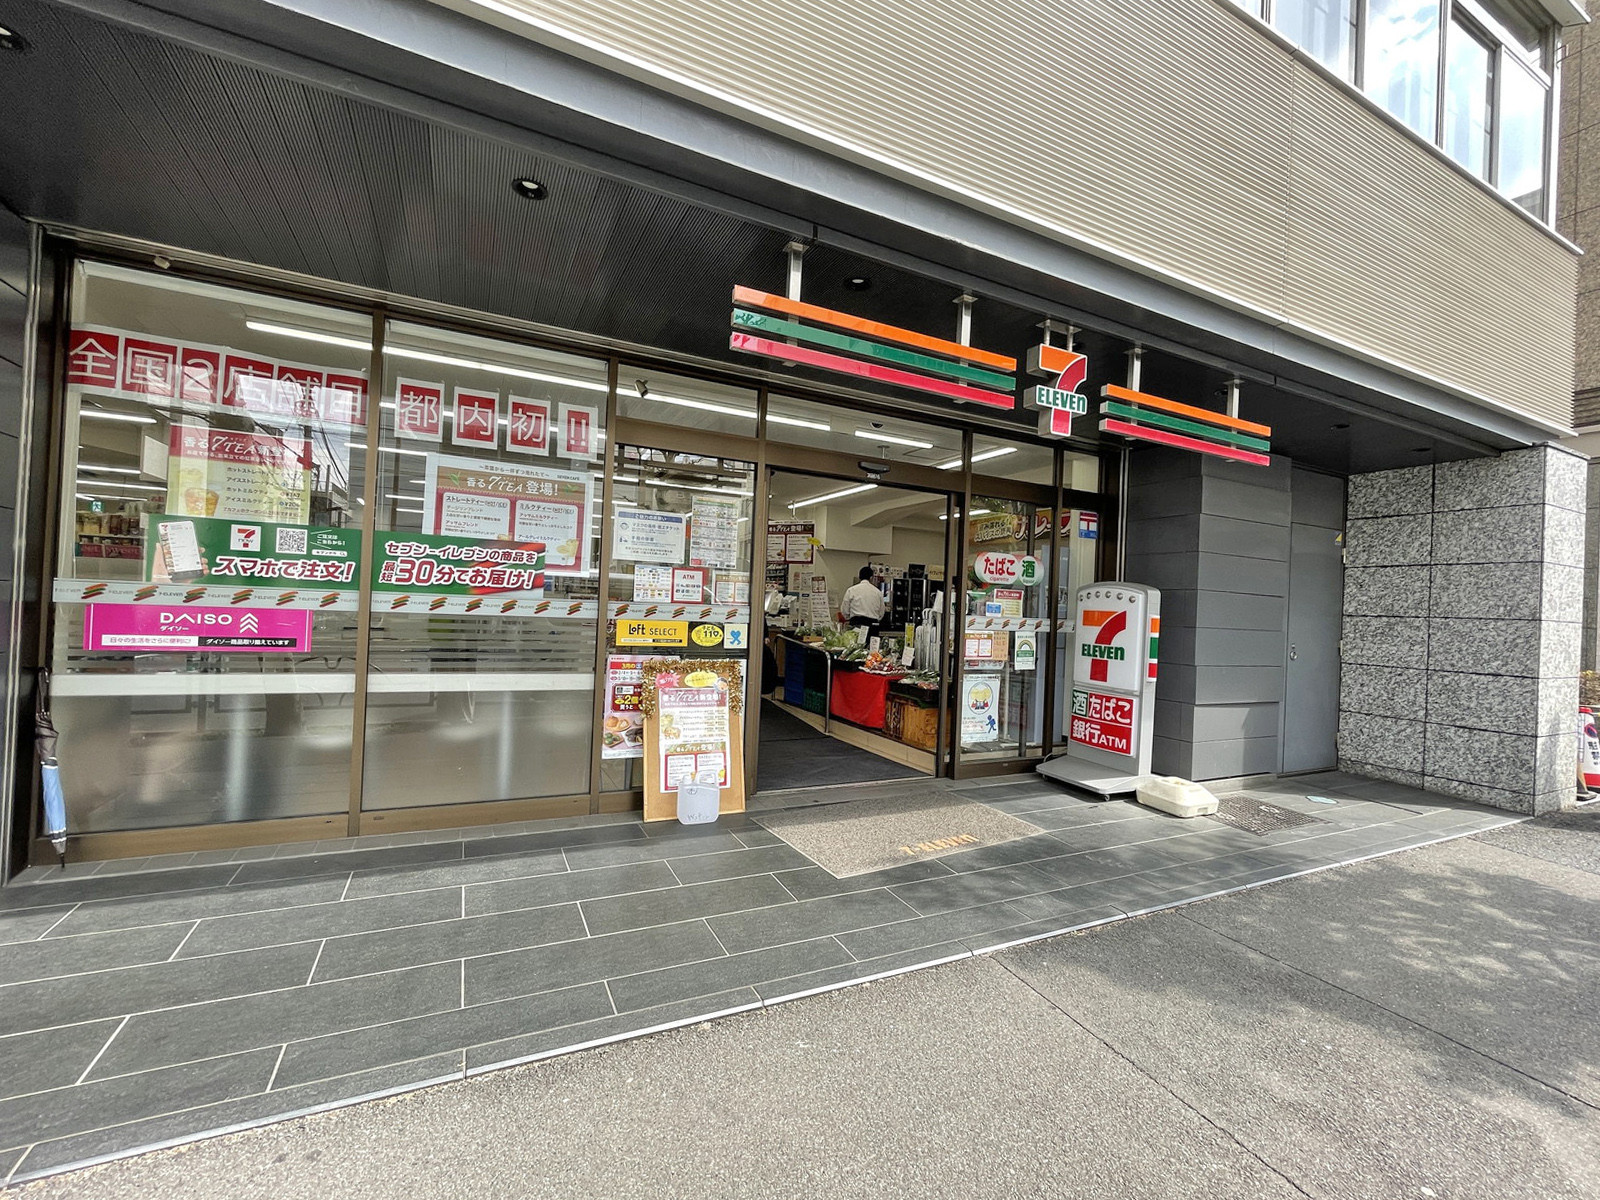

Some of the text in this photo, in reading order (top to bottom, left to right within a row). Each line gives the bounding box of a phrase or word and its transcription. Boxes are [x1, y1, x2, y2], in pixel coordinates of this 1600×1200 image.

[69, 338, 362, 418] 全国2店舗目
[984, 557, 1035, 578] たばこ 酒
[160, 612, 232, 625] DAISO
[649, 628, 677, 636] SELECT
[1073, 691, 1131, 724] 酒 たばこ
[1073, 719, 1127, 750] 銀行ATM
